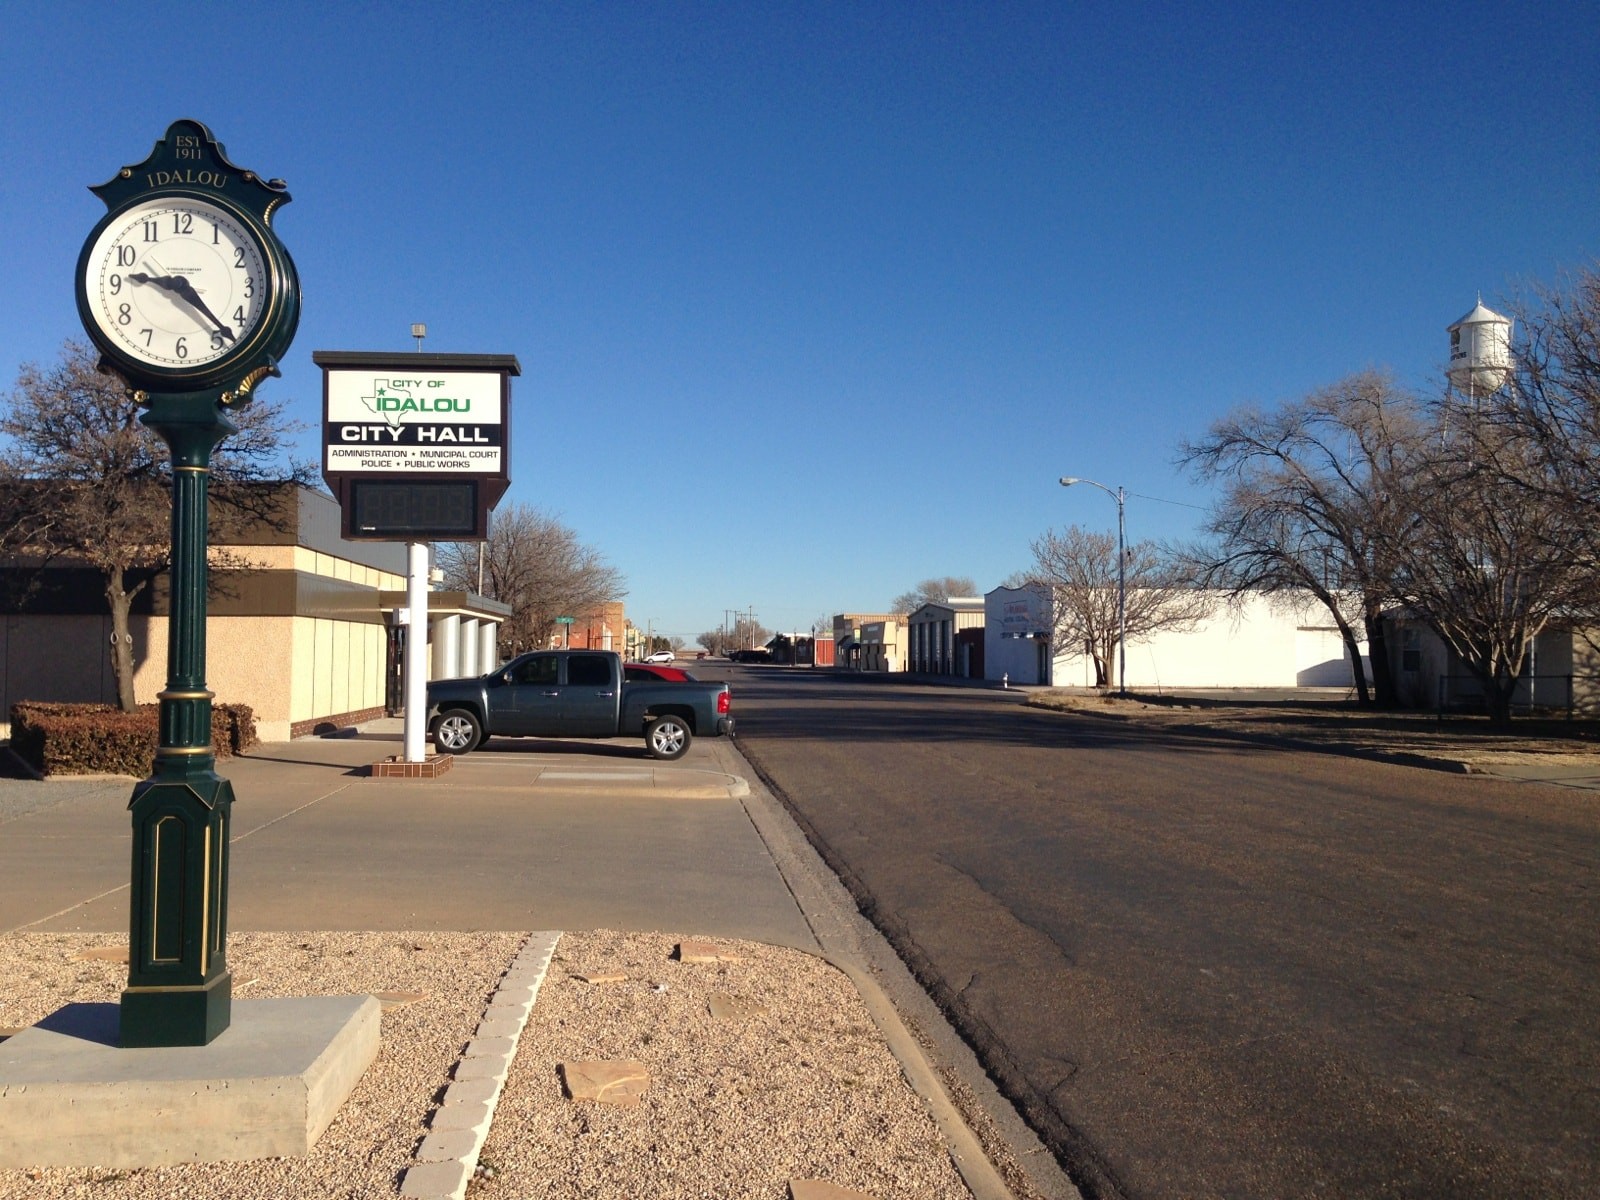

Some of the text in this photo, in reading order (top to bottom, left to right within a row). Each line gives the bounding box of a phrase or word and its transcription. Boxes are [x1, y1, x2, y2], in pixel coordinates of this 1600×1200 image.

[176, 135, 200, 147] EST
[175, 148, 201, 160] 1911
[147, 169, 227, 188] IDALOU
[143, 221, 159, 242] 11
[173, 213, 193, 234] 12
[211, 224, 219, 244] 1
[116, 245, 136, 266] 10
[234, 247, 246, 269] 2
[110, 274, 121, 295] 9
[244, 277, 255, 298] 3
[119, 303, 131, 325] 8
[233, 305, 246, 327] 4
[139, 329, 153, 346] 7
[176, 337, 187, 358] 6
[210, 330, 223, 350] 5
[392, 380, 445, 388] CITY OF
[376, 398, 470, 412] IDALOU
[341, 426, 488, 442] CITY HALL
[404, 460, 435, 468] PUBLIC
[469, 451, 498, 459] COURT
